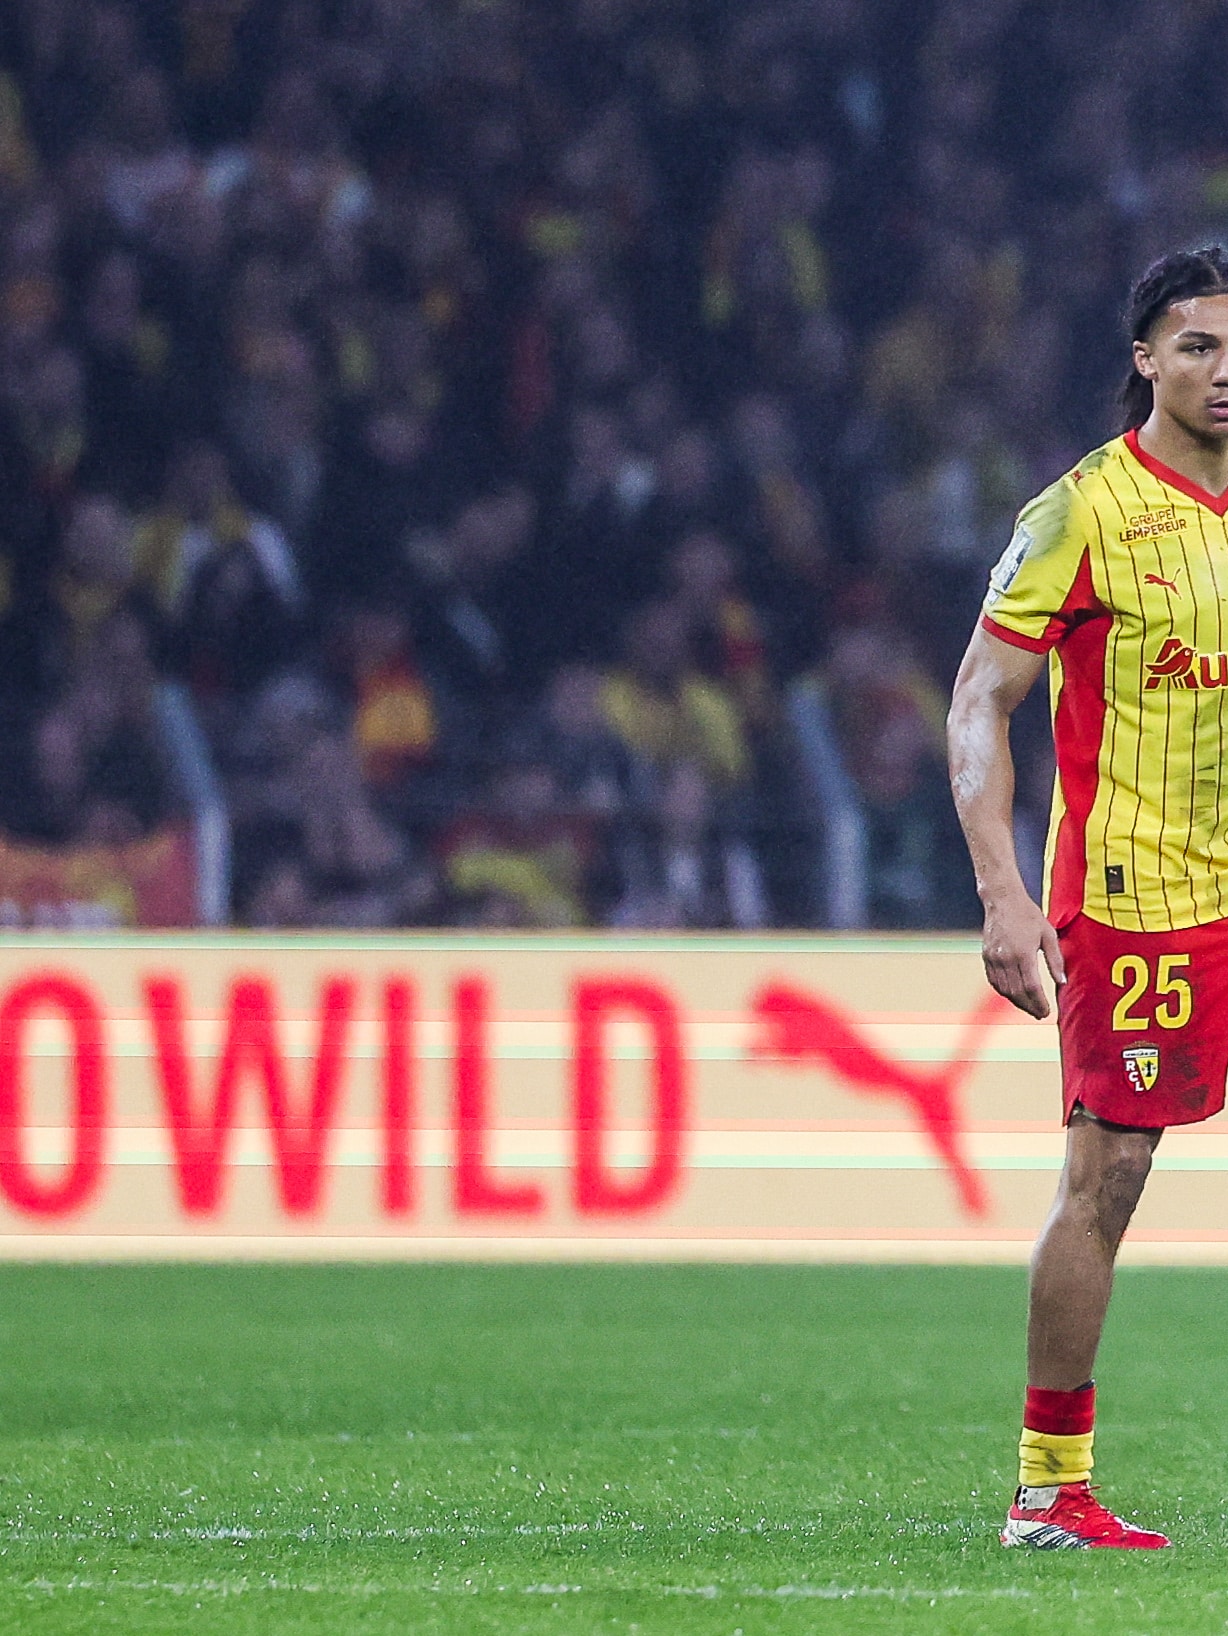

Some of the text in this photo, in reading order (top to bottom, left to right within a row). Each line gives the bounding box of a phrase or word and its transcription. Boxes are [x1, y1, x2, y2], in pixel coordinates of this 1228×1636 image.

[1119, 519, 1187, 542] LEMPEREUR
[1129, 509, 1172, 527] GROUPE
[1111, 954, 1192, 1031] 25
[1125, 1060, 1145, 1092] RCL
